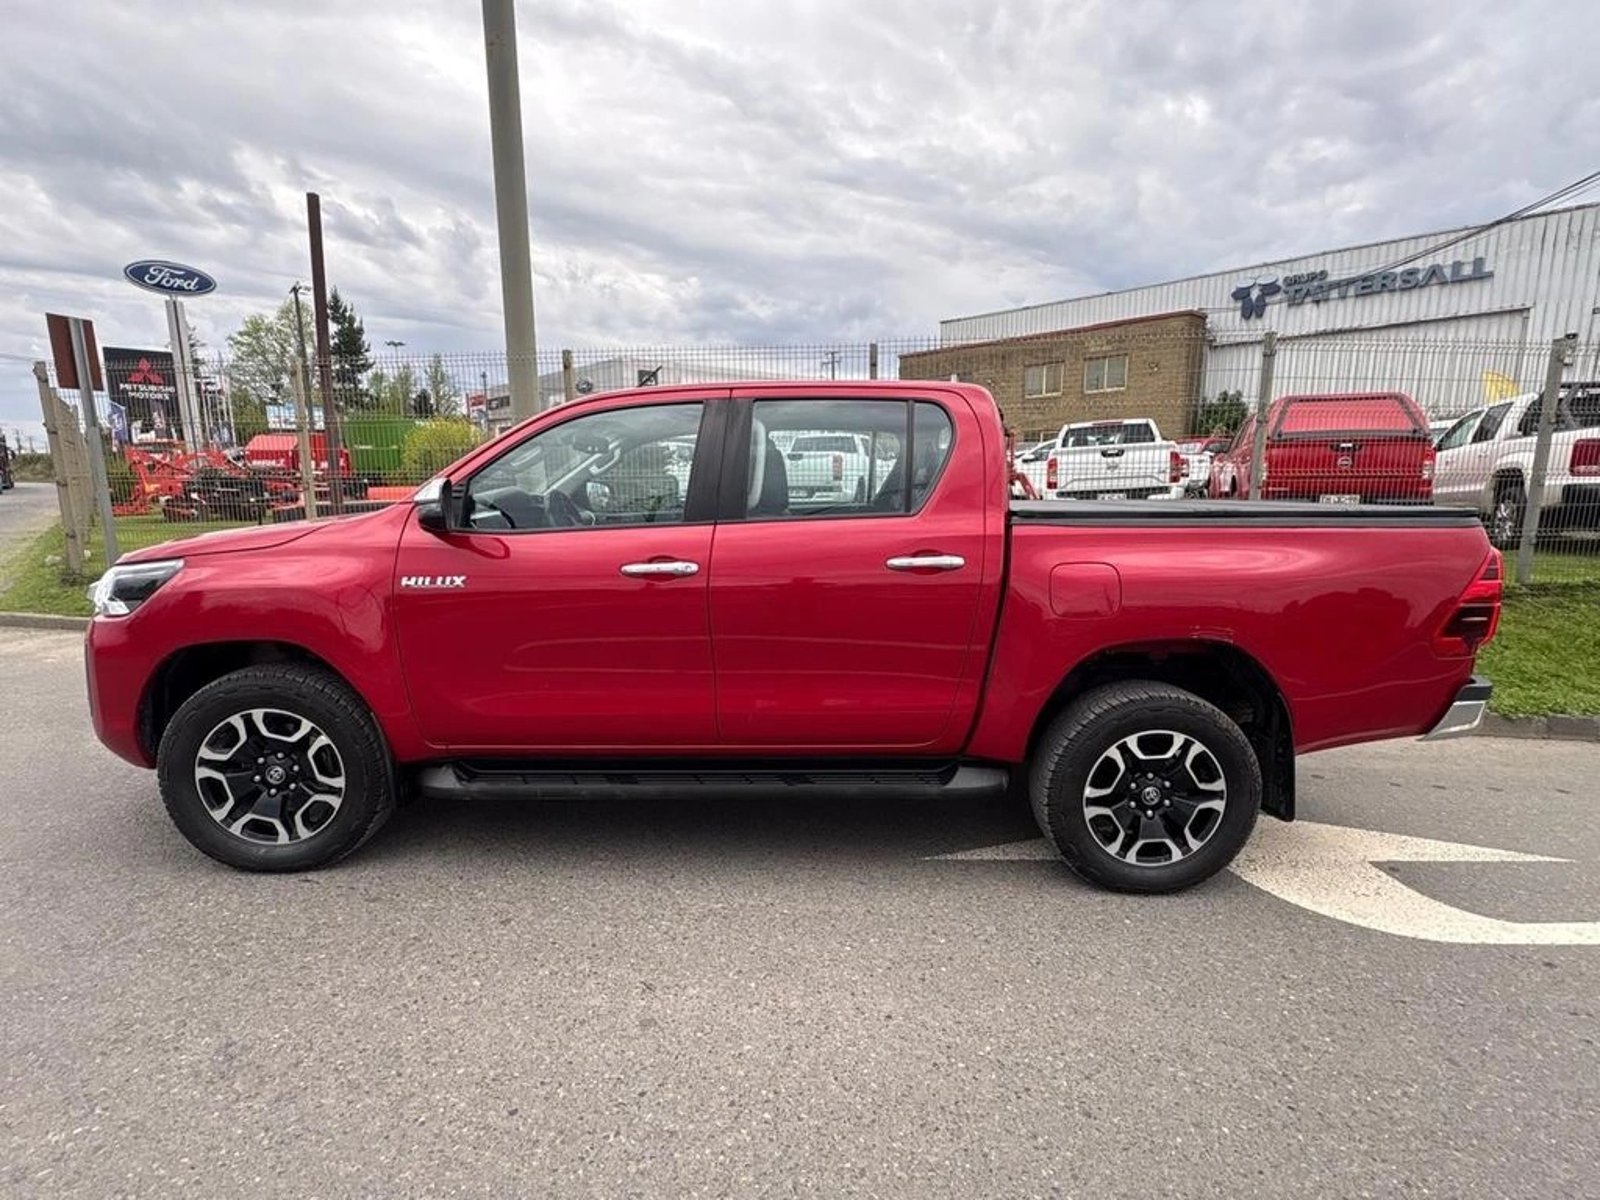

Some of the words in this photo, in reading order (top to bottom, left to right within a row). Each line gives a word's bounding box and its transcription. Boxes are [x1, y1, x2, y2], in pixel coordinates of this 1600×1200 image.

[144, 266, 199, 291] Ford
[1283, 270, 1328, 287] GRUPO
[1283, 257, 1494, 307] TATTERSALL
[119, 383, 176, 393] MITSUBISHI
[128, 391, 170, 400] MOTORS
[401, 575, 467, 588] HILUX
